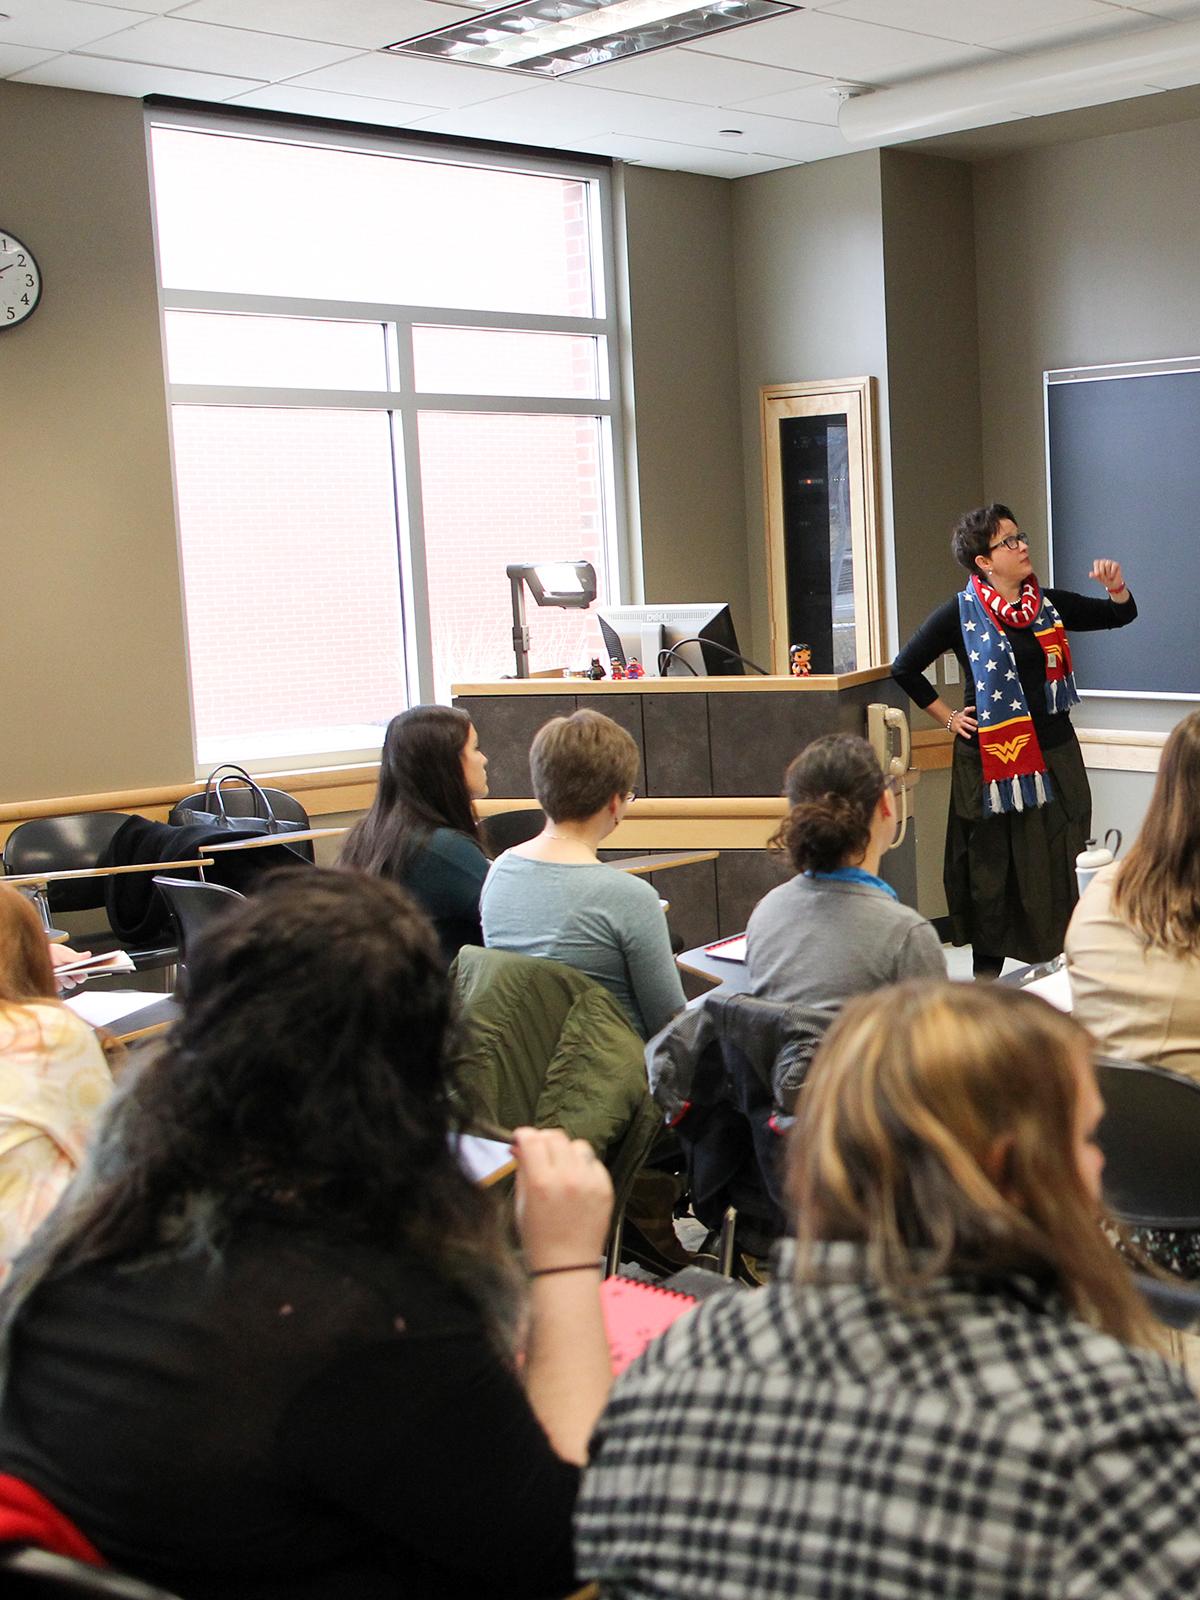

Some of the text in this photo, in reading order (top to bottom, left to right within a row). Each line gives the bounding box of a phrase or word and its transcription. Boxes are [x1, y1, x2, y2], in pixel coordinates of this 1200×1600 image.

[2, 239, 8, 251] 1
[17, 254, 27, 267] 2
[25, 273, 35, 287] 3
[20, 292, 30, 306] 4
[6, 306, 16, 320] 5
